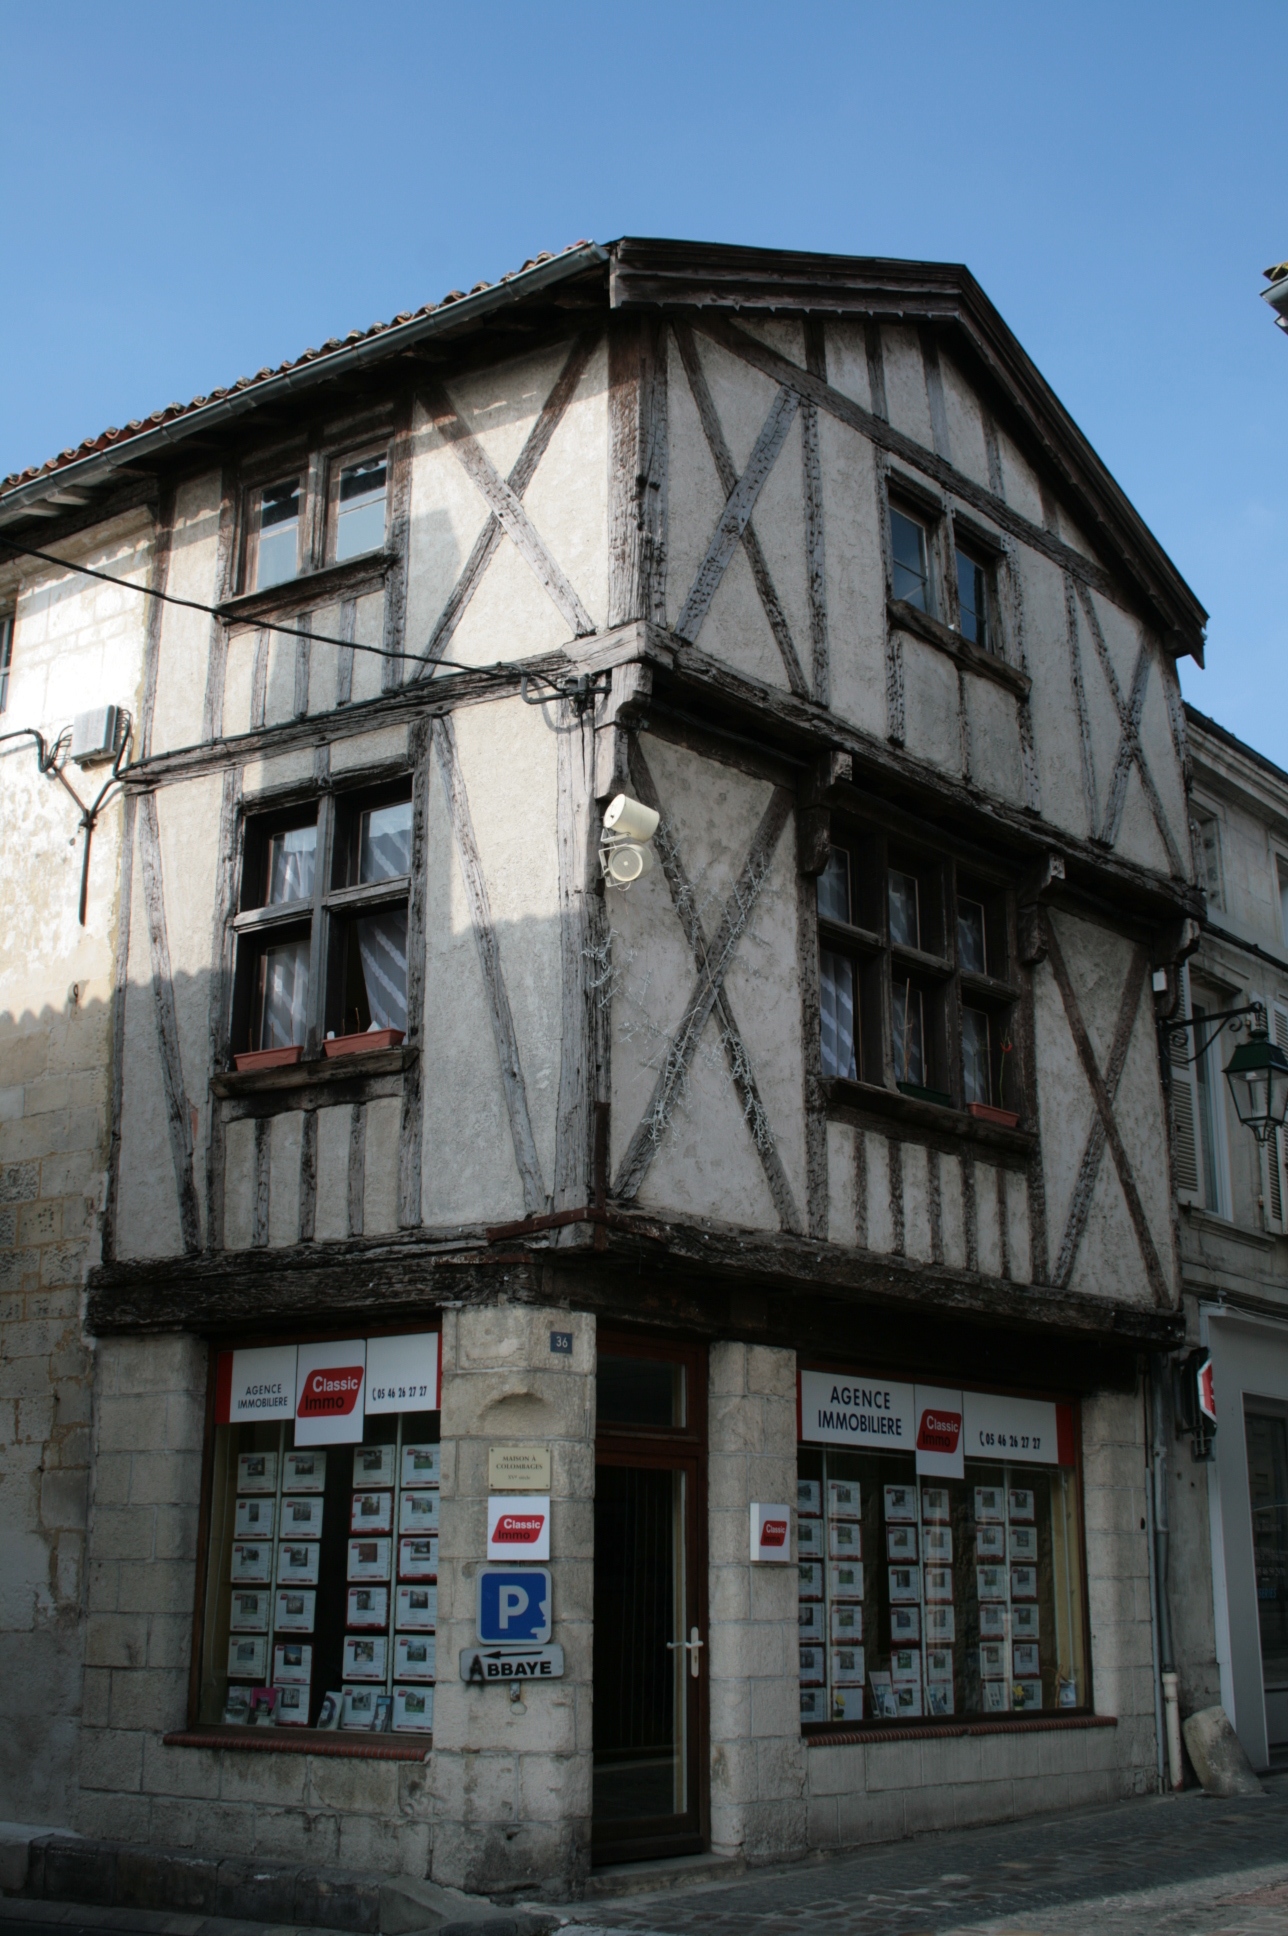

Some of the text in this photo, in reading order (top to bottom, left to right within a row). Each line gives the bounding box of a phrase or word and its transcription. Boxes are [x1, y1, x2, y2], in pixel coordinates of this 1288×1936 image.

[556, 1336, 568, 1348] 36
[245, 1384, 282, 1396] AGENCE
[313, 1376, 358, 1392] Classic
[377, 1386, 427, 1400] 05 46 26 27 27
[830, 1386, 890, 1410] AGENCE
[238, 1396, 288, 1409] IMMOBILIERE
[305, 1395, 344, 1410] Immo
[818, 1410, 902, 1436] IMMOBILIERE
[926, 1415, 959, 1433] Classic
[922, 1431, 950, 1447] Immo
[986, 1434, 1041, 1450] 05 46 26 27 27
[532, 1454, 536, 1462] À
[504, 1518, 540, 1529] Classic
[766, 1524, 786, 1534] Classic
[498, 1530, 530, 1540] Immo
[499, 1585, 530, 1629] P
[468, 1655, 552, 1682] ABBAYE
